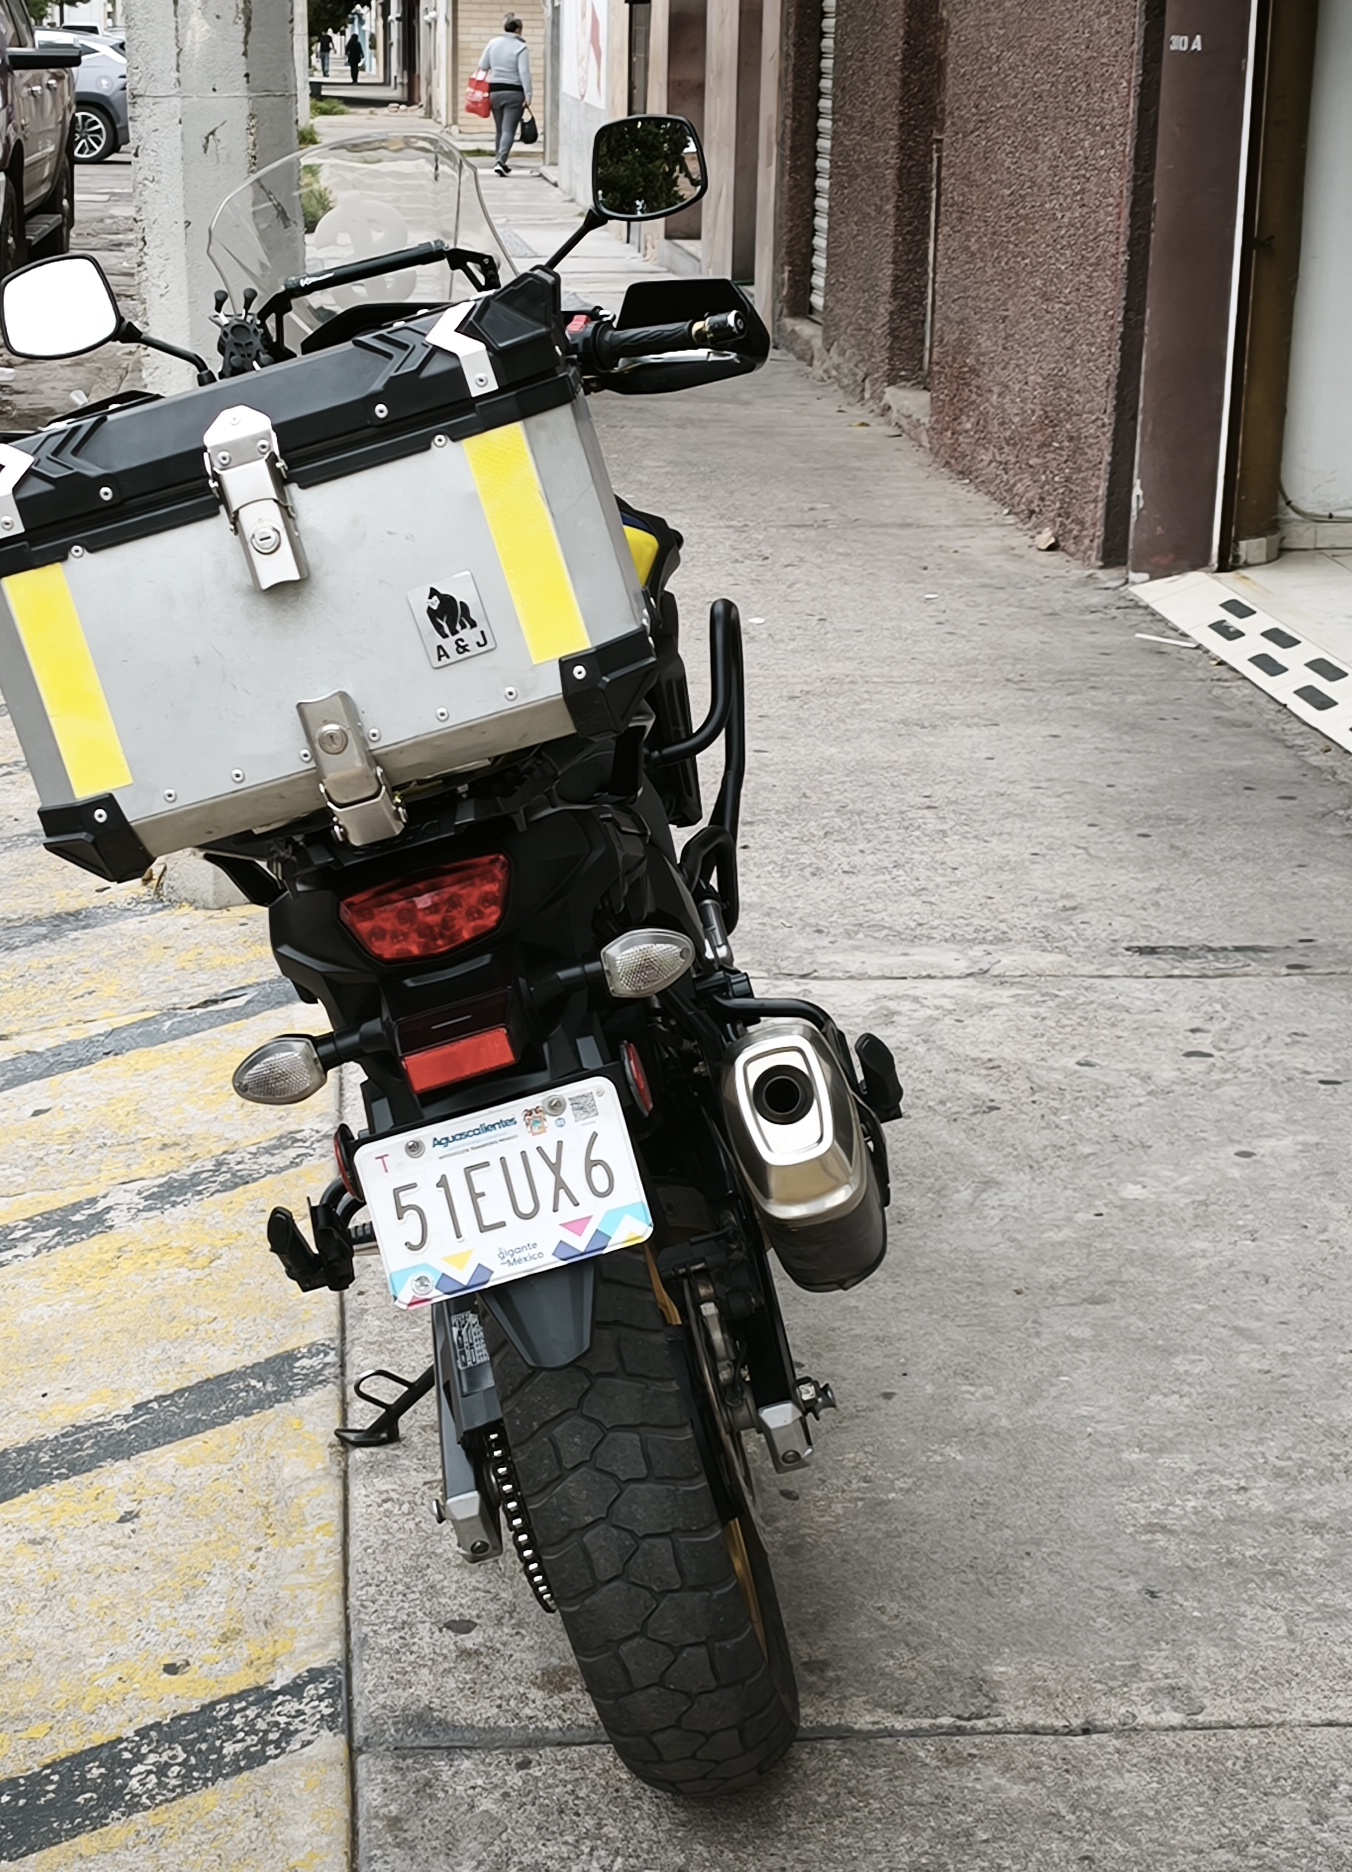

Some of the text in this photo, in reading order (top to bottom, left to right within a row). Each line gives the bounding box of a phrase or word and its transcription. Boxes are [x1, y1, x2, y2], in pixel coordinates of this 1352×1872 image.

[436, 630, 488, 661] A & J
[432, 1117, 518, 1148] Aguascalientes
[375, 1154, 389, 1174] T
[393, 1131, 615, 1251] 51EUX6
